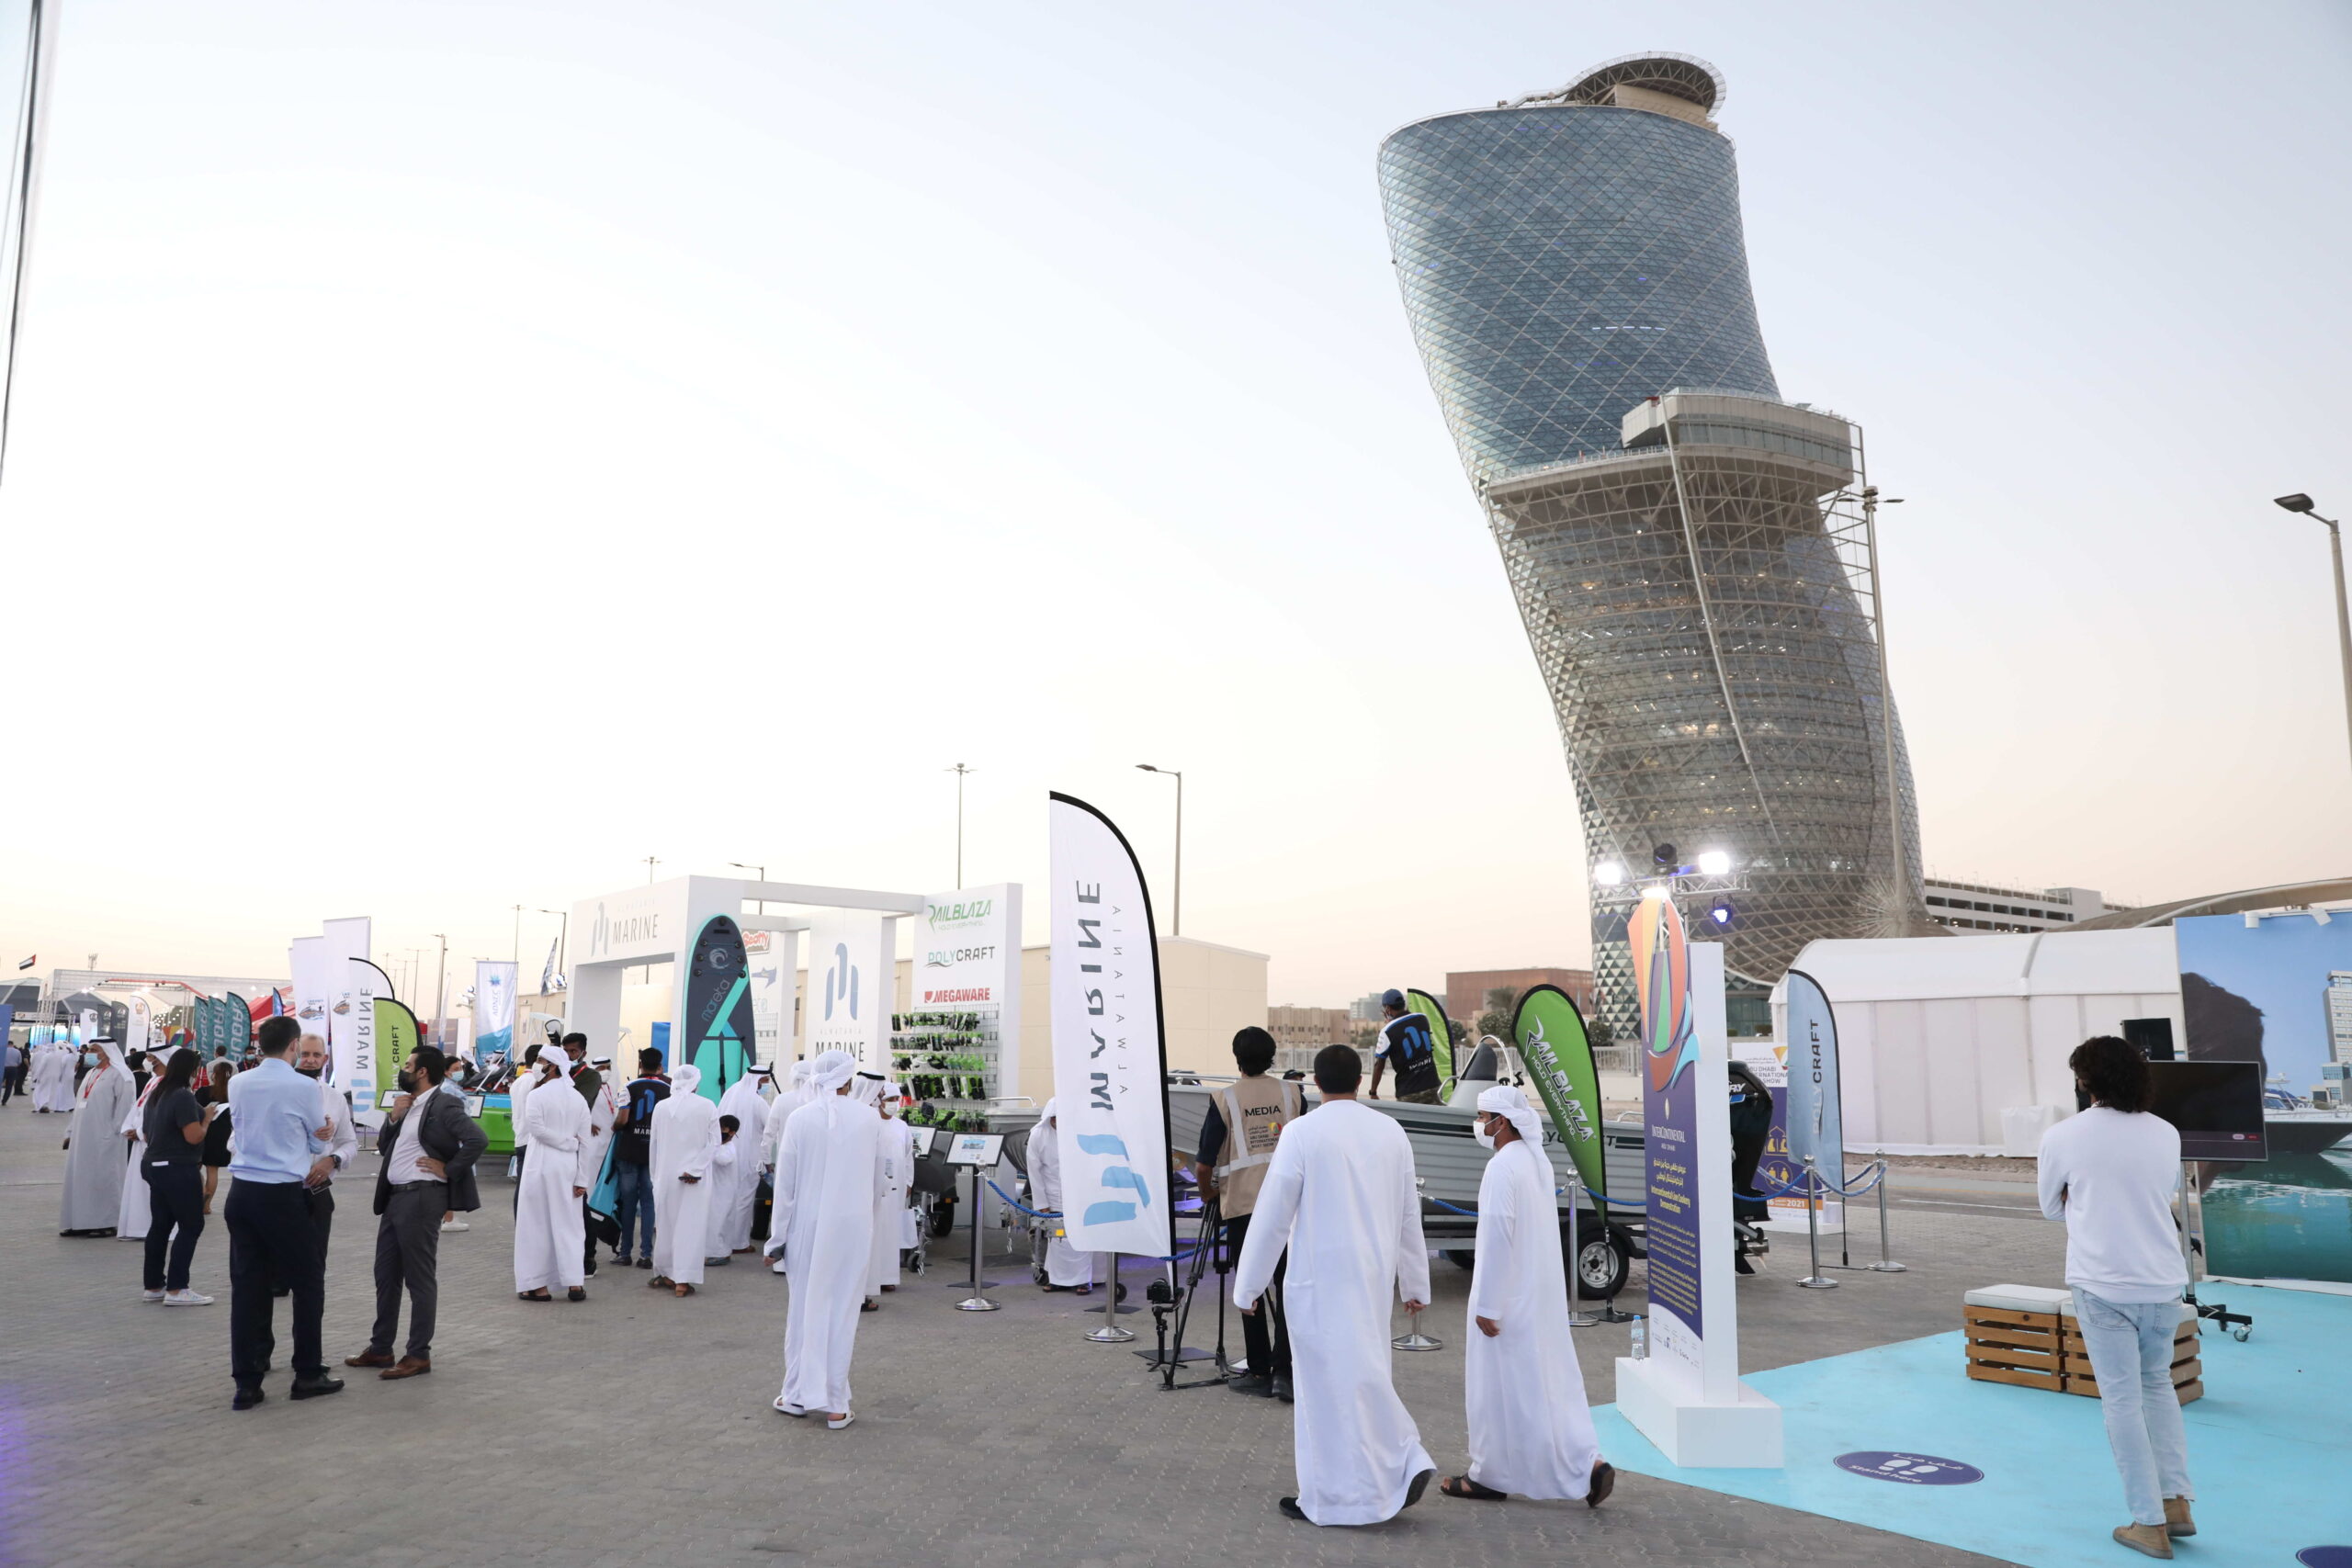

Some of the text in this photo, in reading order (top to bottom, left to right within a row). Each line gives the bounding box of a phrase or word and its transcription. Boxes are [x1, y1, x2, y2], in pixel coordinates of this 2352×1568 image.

[928, 900, 992, 931] RAILBLAZA
[613, 914, 659, 944] MARINE
[928, 946, 995, 964] POLYCRAFT
[933, 987, 989, 1003] MEGAWARE
[1531, 1055, 1547, 1079] HOLD
[1810, 1019, 1823, 1134] POLYCRAFT
[1524, 1014, 1594, 1143] RAILBLAZA
[1244, 1105, 1282, 1118] MEDIA
[634, 1127, 650, 1135] MAR
[1786, 1199, 1805, 1208] 2021
[1849, 1464, 1923, 1483] Stand here
